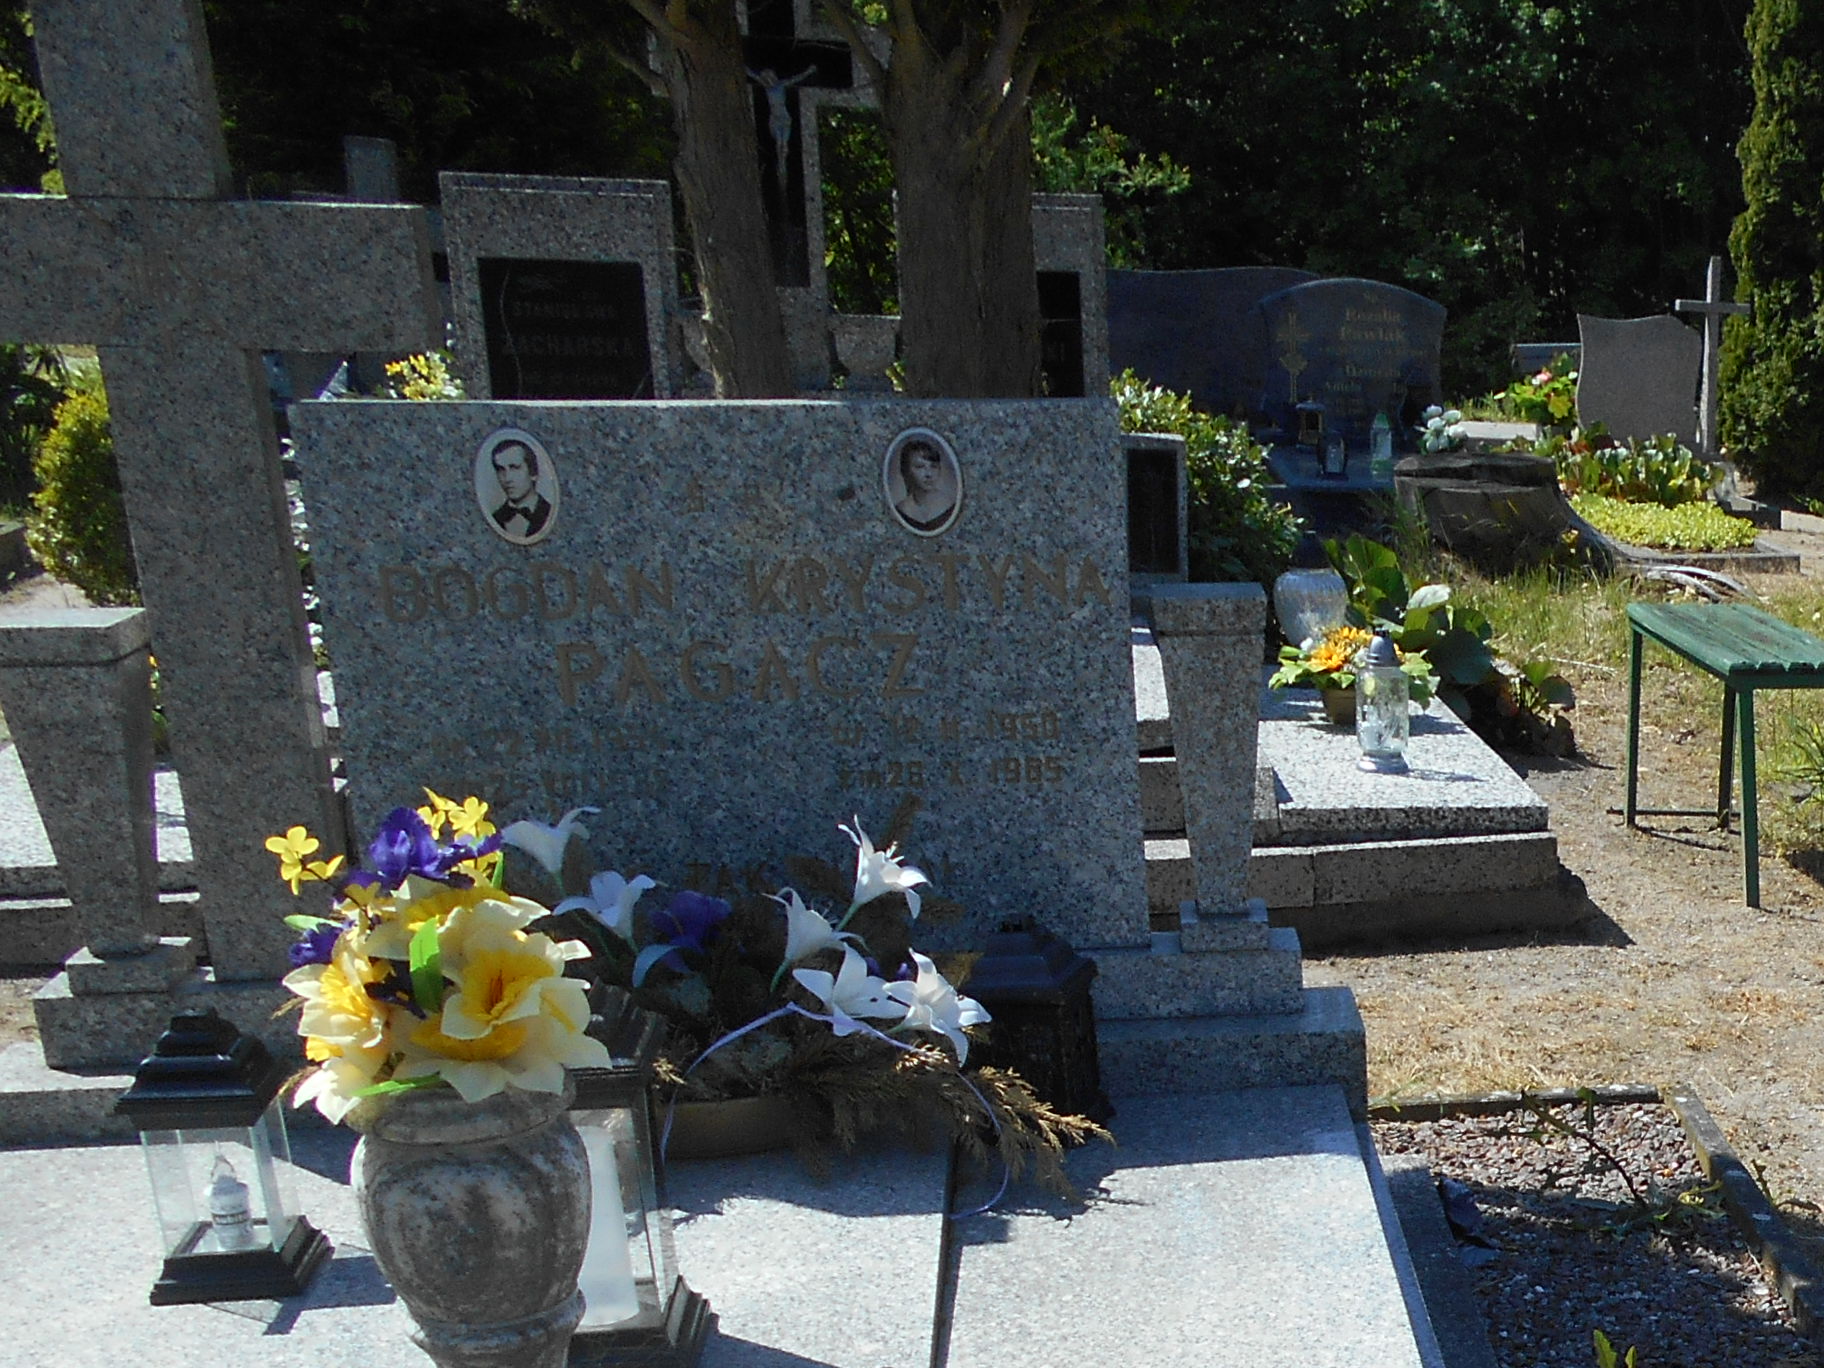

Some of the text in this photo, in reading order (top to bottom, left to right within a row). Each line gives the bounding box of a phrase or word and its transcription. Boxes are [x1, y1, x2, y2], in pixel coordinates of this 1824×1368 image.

[378, 552, 1114, 623] BOGDAN KRYSTYNA
[554, 632, 929, 706] PAGACZ
[986, 705, 1063, 742] 1950
[990, 754, 1068, 785] 1985
